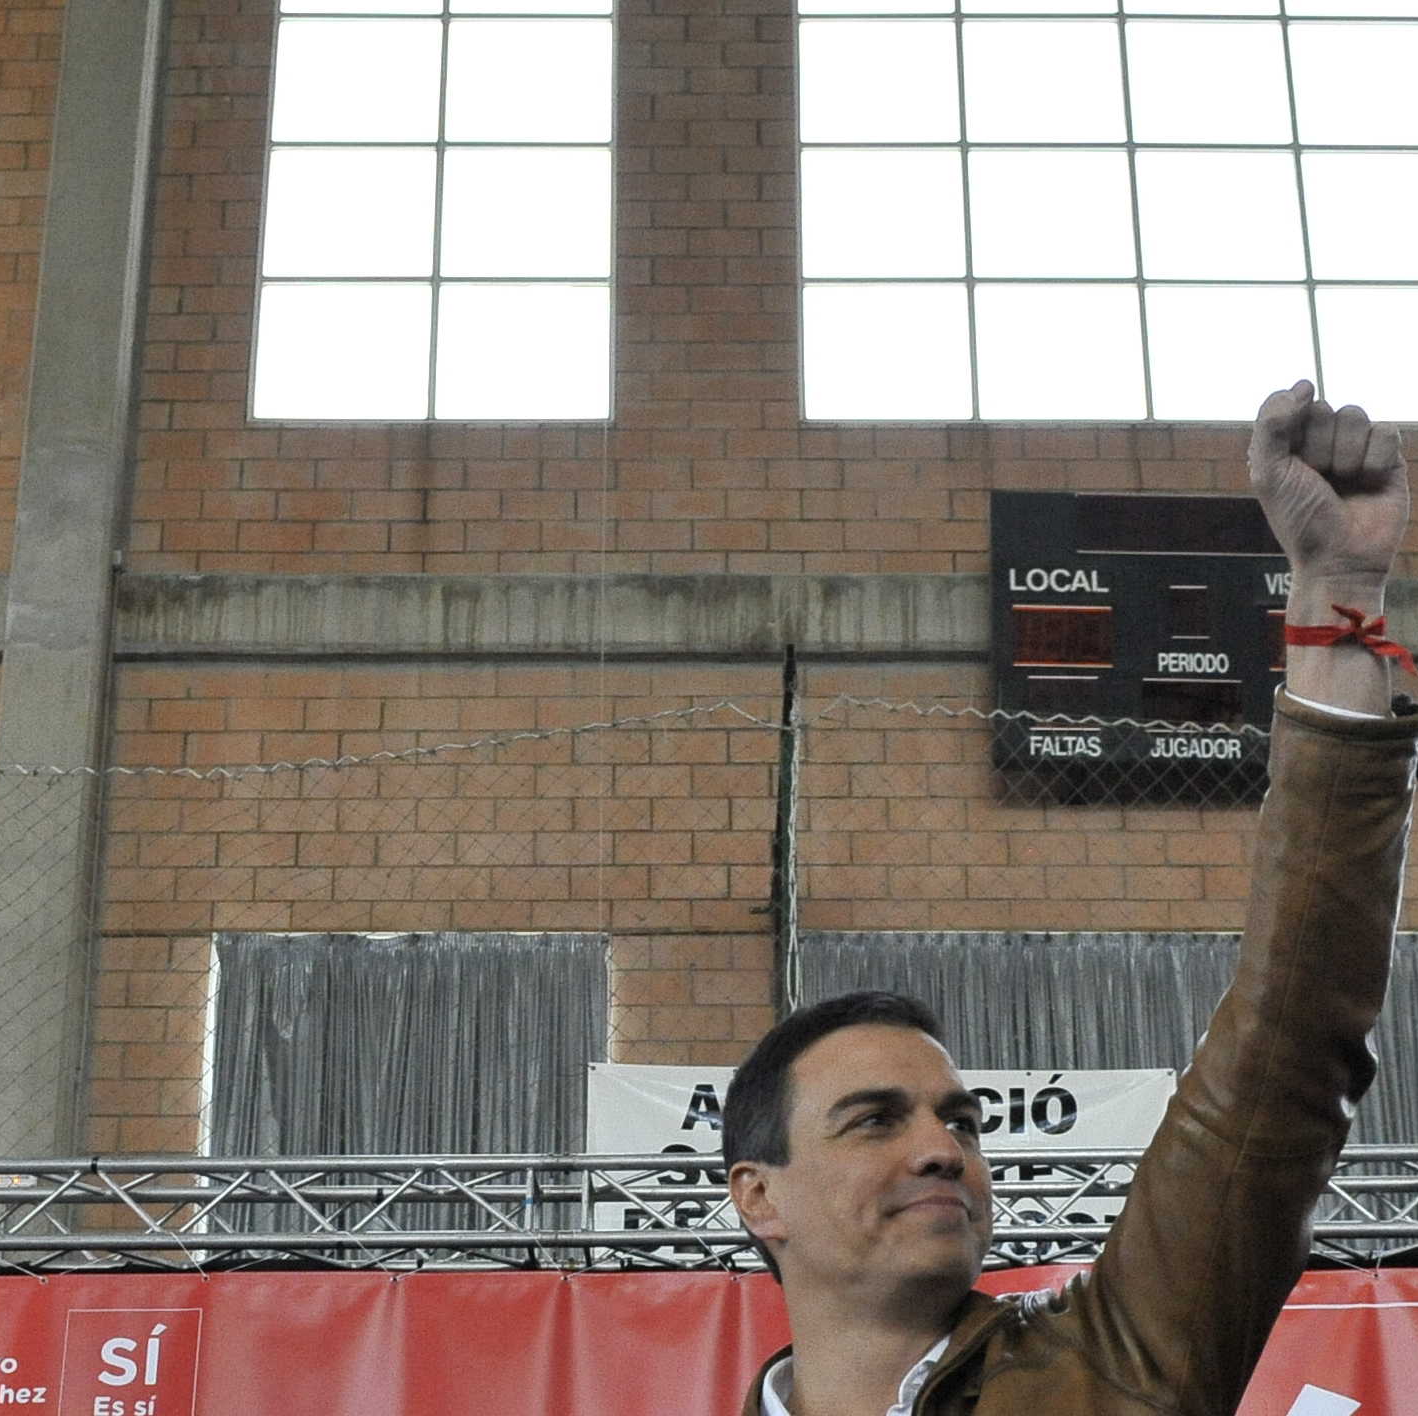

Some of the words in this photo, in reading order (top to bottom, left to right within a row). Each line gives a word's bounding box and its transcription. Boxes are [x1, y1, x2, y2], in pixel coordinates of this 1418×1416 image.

[1009, 568, 1109, 593] LOCAL
[1264, 573, 1292, 595] VIS
[1158, 653, 1229, 674] PERIODO
[1030, 736, 1101, 758] FALTAS
[1150, 738, 1241, 760] JUGADOR
[98, 1324, 167, 1386] SÍ
[94, 1397, 124, 1416] Es
[134, 1396, 156, 1416] sí
